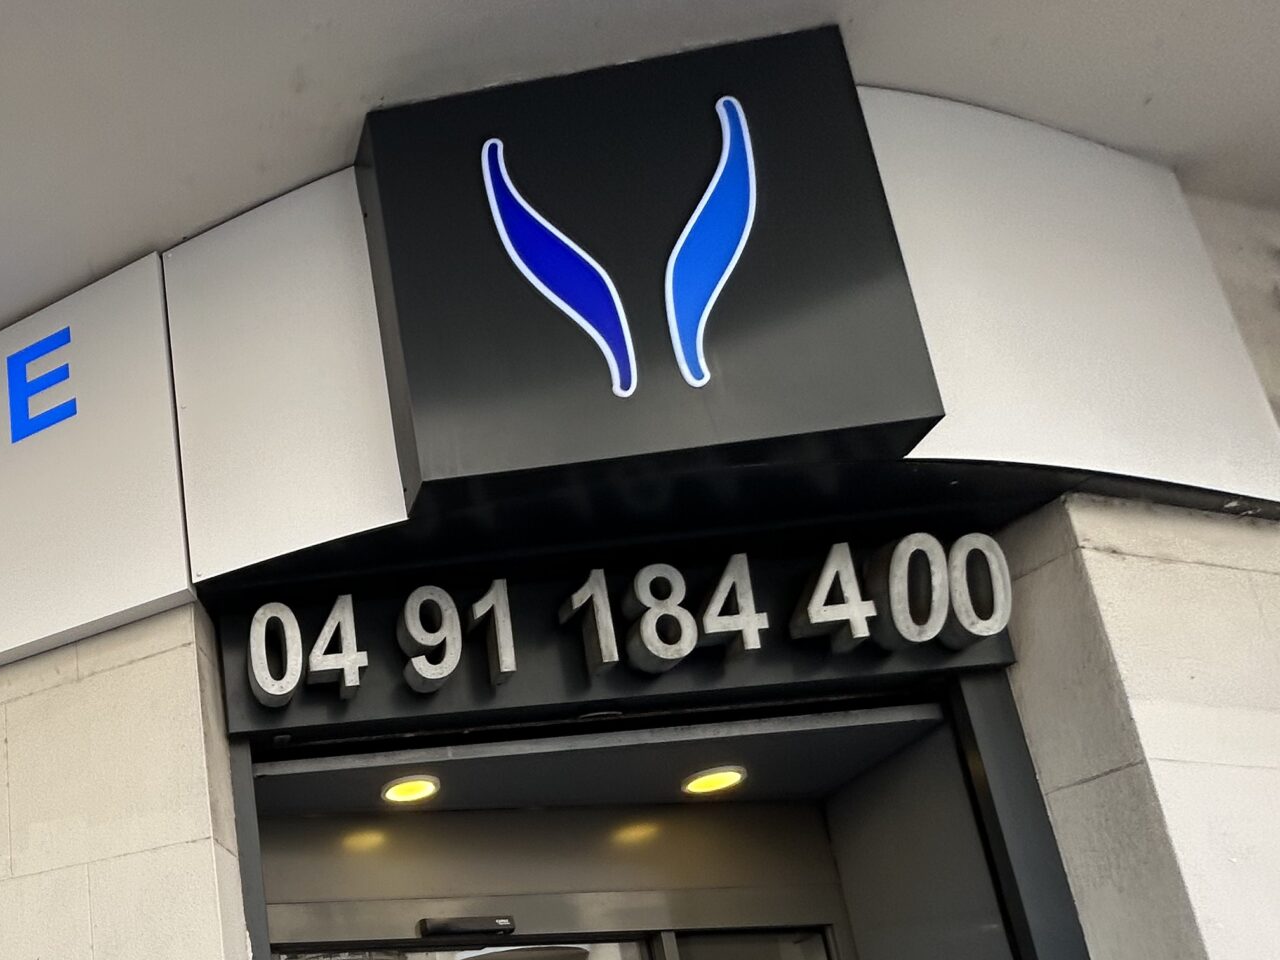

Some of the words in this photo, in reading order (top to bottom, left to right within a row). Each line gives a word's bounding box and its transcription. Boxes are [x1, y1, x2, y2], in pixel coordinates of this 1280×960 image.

[249, 594, 369, 708] 04
[398, 579, 517, 693] 91
[561, 552, 768, 674] 184
